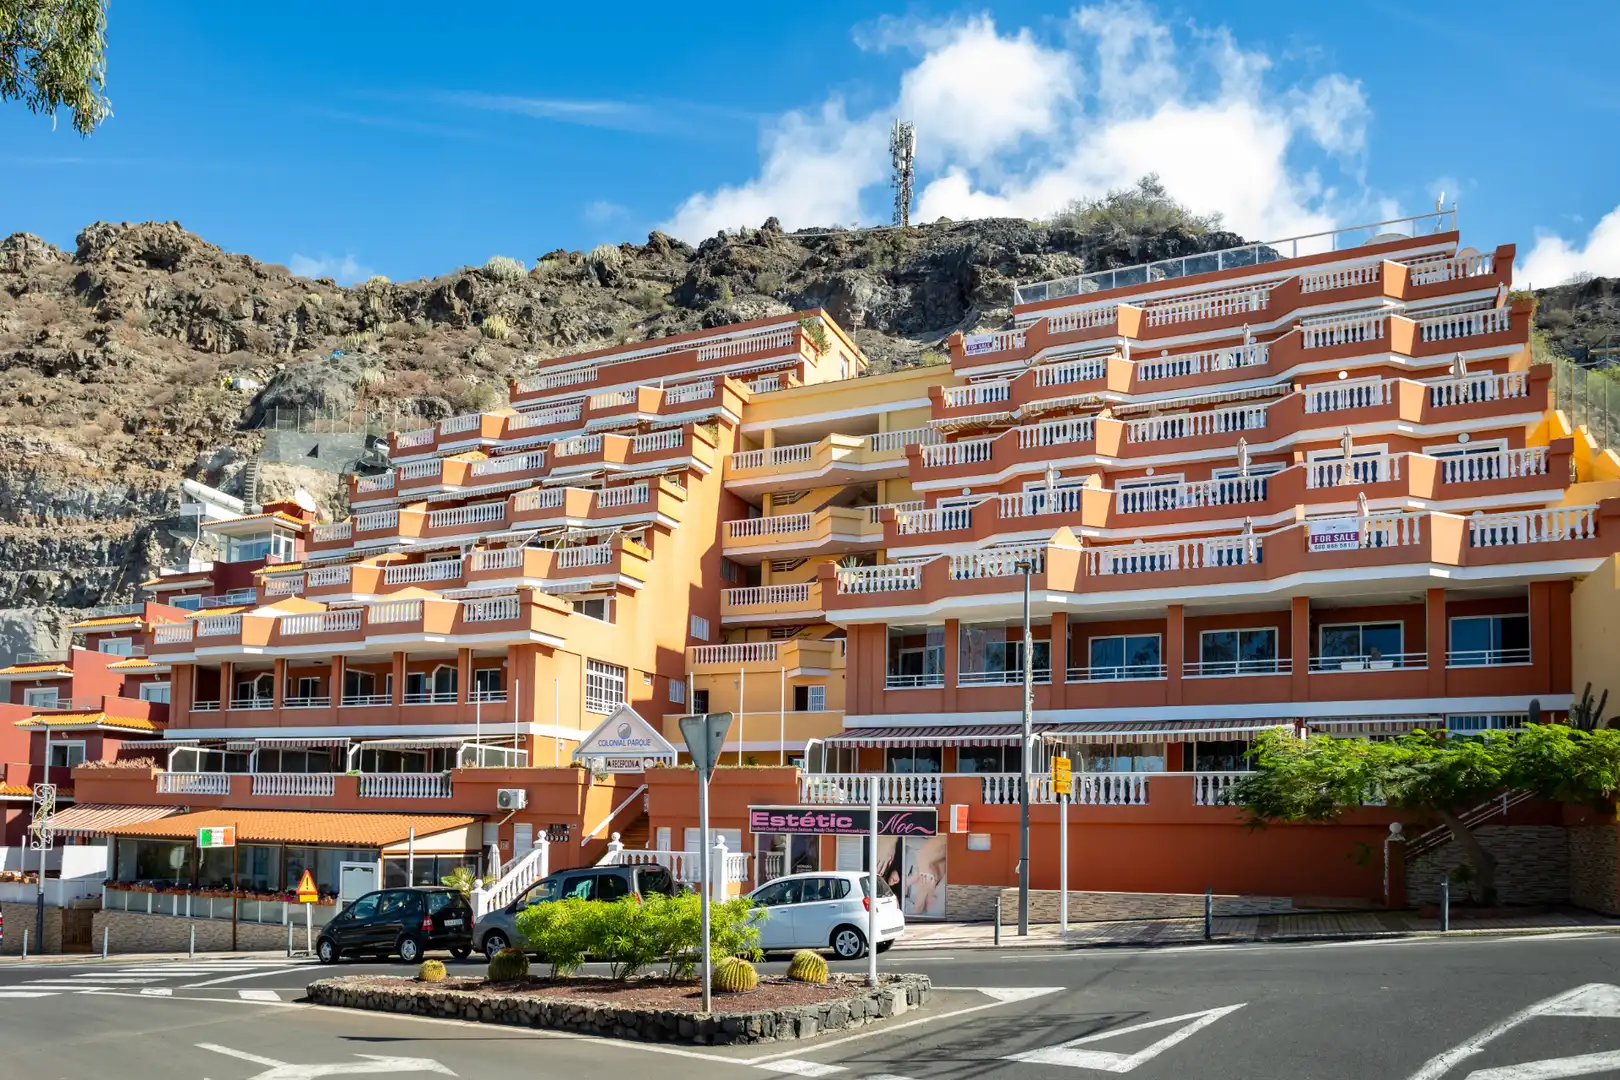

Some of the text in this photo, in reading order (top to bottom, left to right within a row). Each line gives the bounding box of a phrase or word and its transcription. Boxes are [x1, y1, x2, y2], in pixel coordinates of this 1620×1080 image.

[1314, 533, 1355, 543] FOR SALE
[627, 738, 651, 747] PARQUE
[752, 811, 935, 834] Estétic Noe
